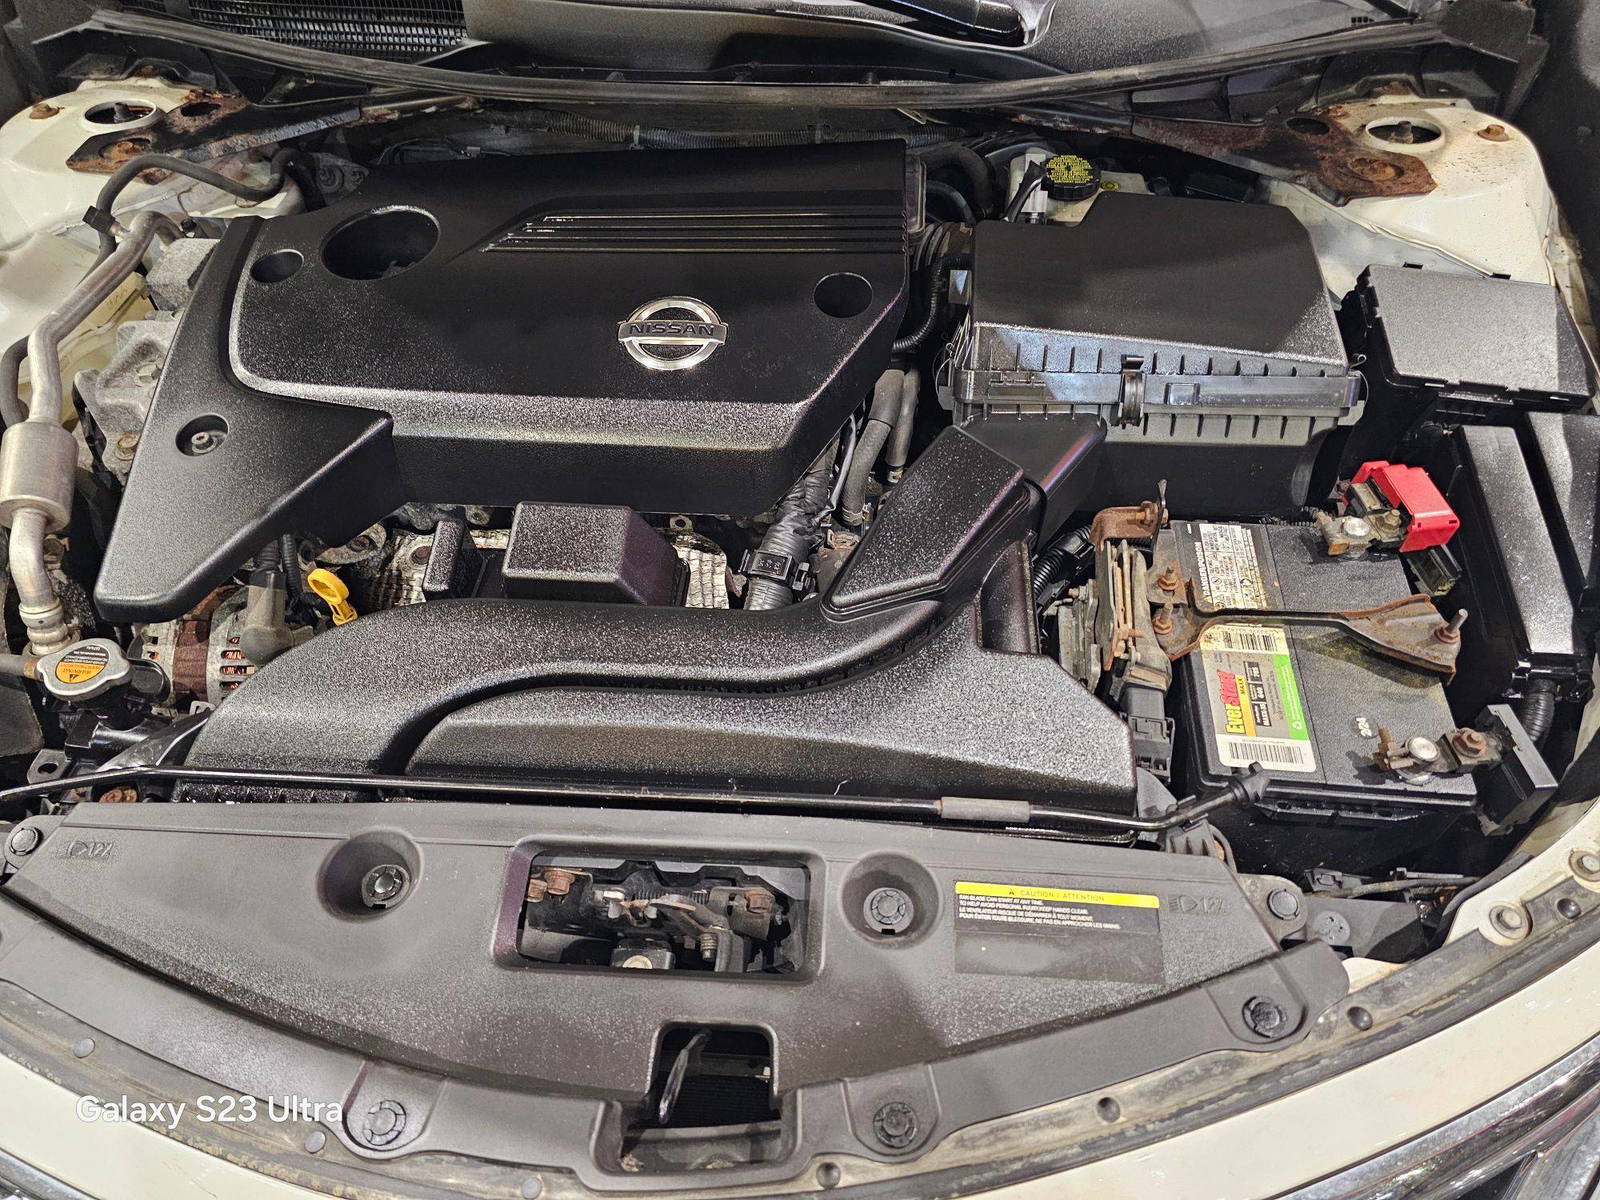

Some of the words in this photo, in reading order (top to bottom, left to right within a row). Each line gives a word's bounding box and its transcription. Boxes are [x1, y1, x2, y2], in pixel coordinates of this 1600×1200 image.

[629, 322, 714, 336] NISSAN
[1020, 889, 1054, 898] CAUTION
[1063, 892, 1104, 902] ATTENTION
